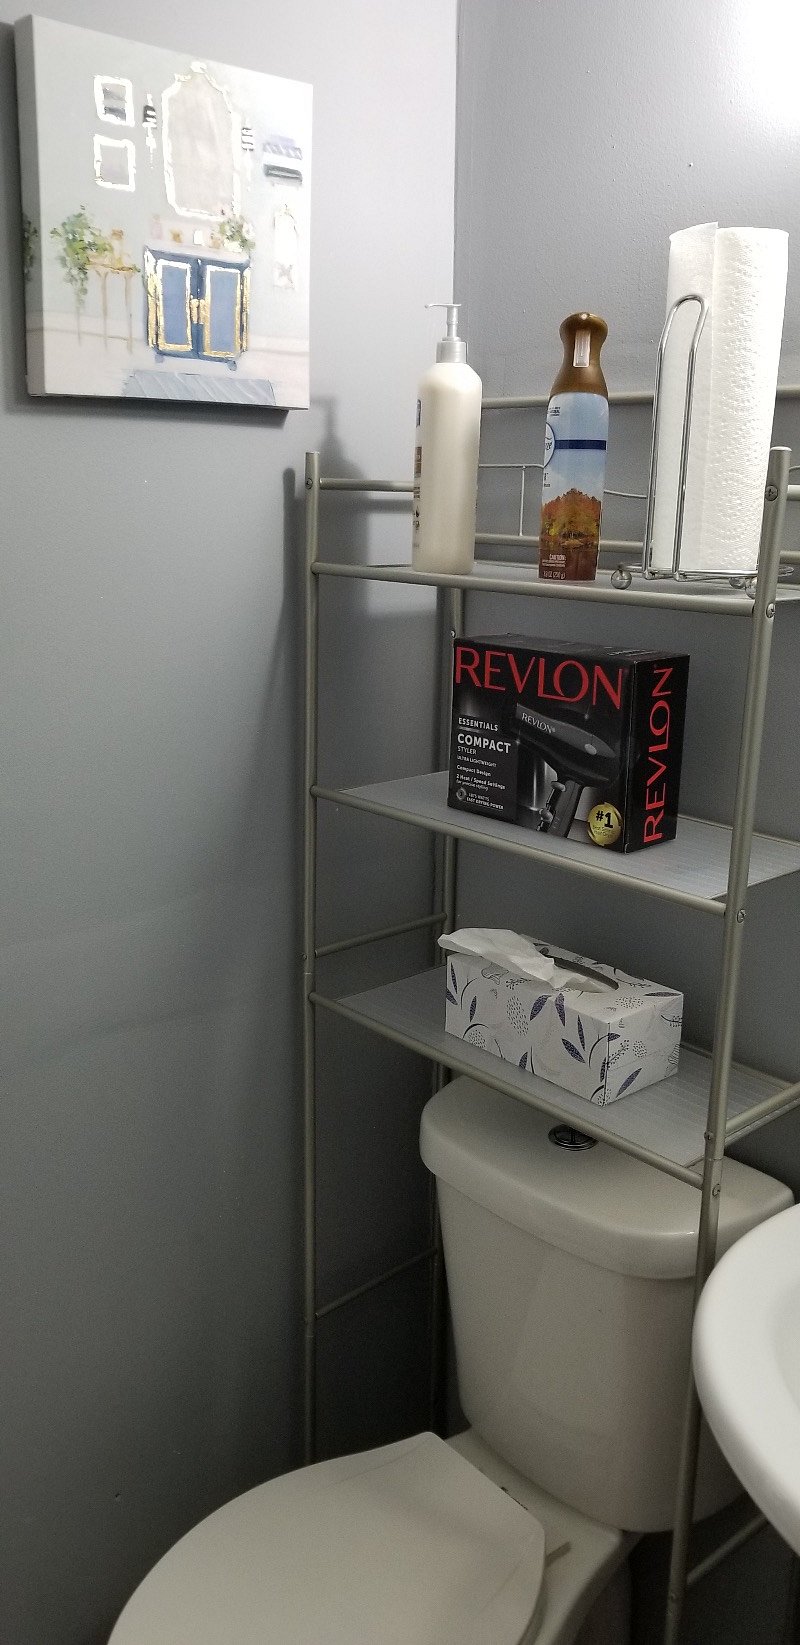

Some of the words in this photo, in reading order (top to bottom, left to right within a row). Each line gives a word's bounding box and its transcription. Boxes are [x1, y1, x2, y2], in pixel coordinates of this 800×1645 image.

[455, 646, 624, 710] REVLON
[458, 717, 499, 732] ESSENTIALS
[457, 733, 512, 754] COMPACT
[457, 745, 477, 755] STYLER
[643, 667, 674, 843] REVLON
[456, 764, 476, 774] Compact
[476, 768, 491, 777] Design
[473, 777, 487, 785] Speed
[487, 780, 506, 790] Settings
[595, 810, 614, 829] #1
